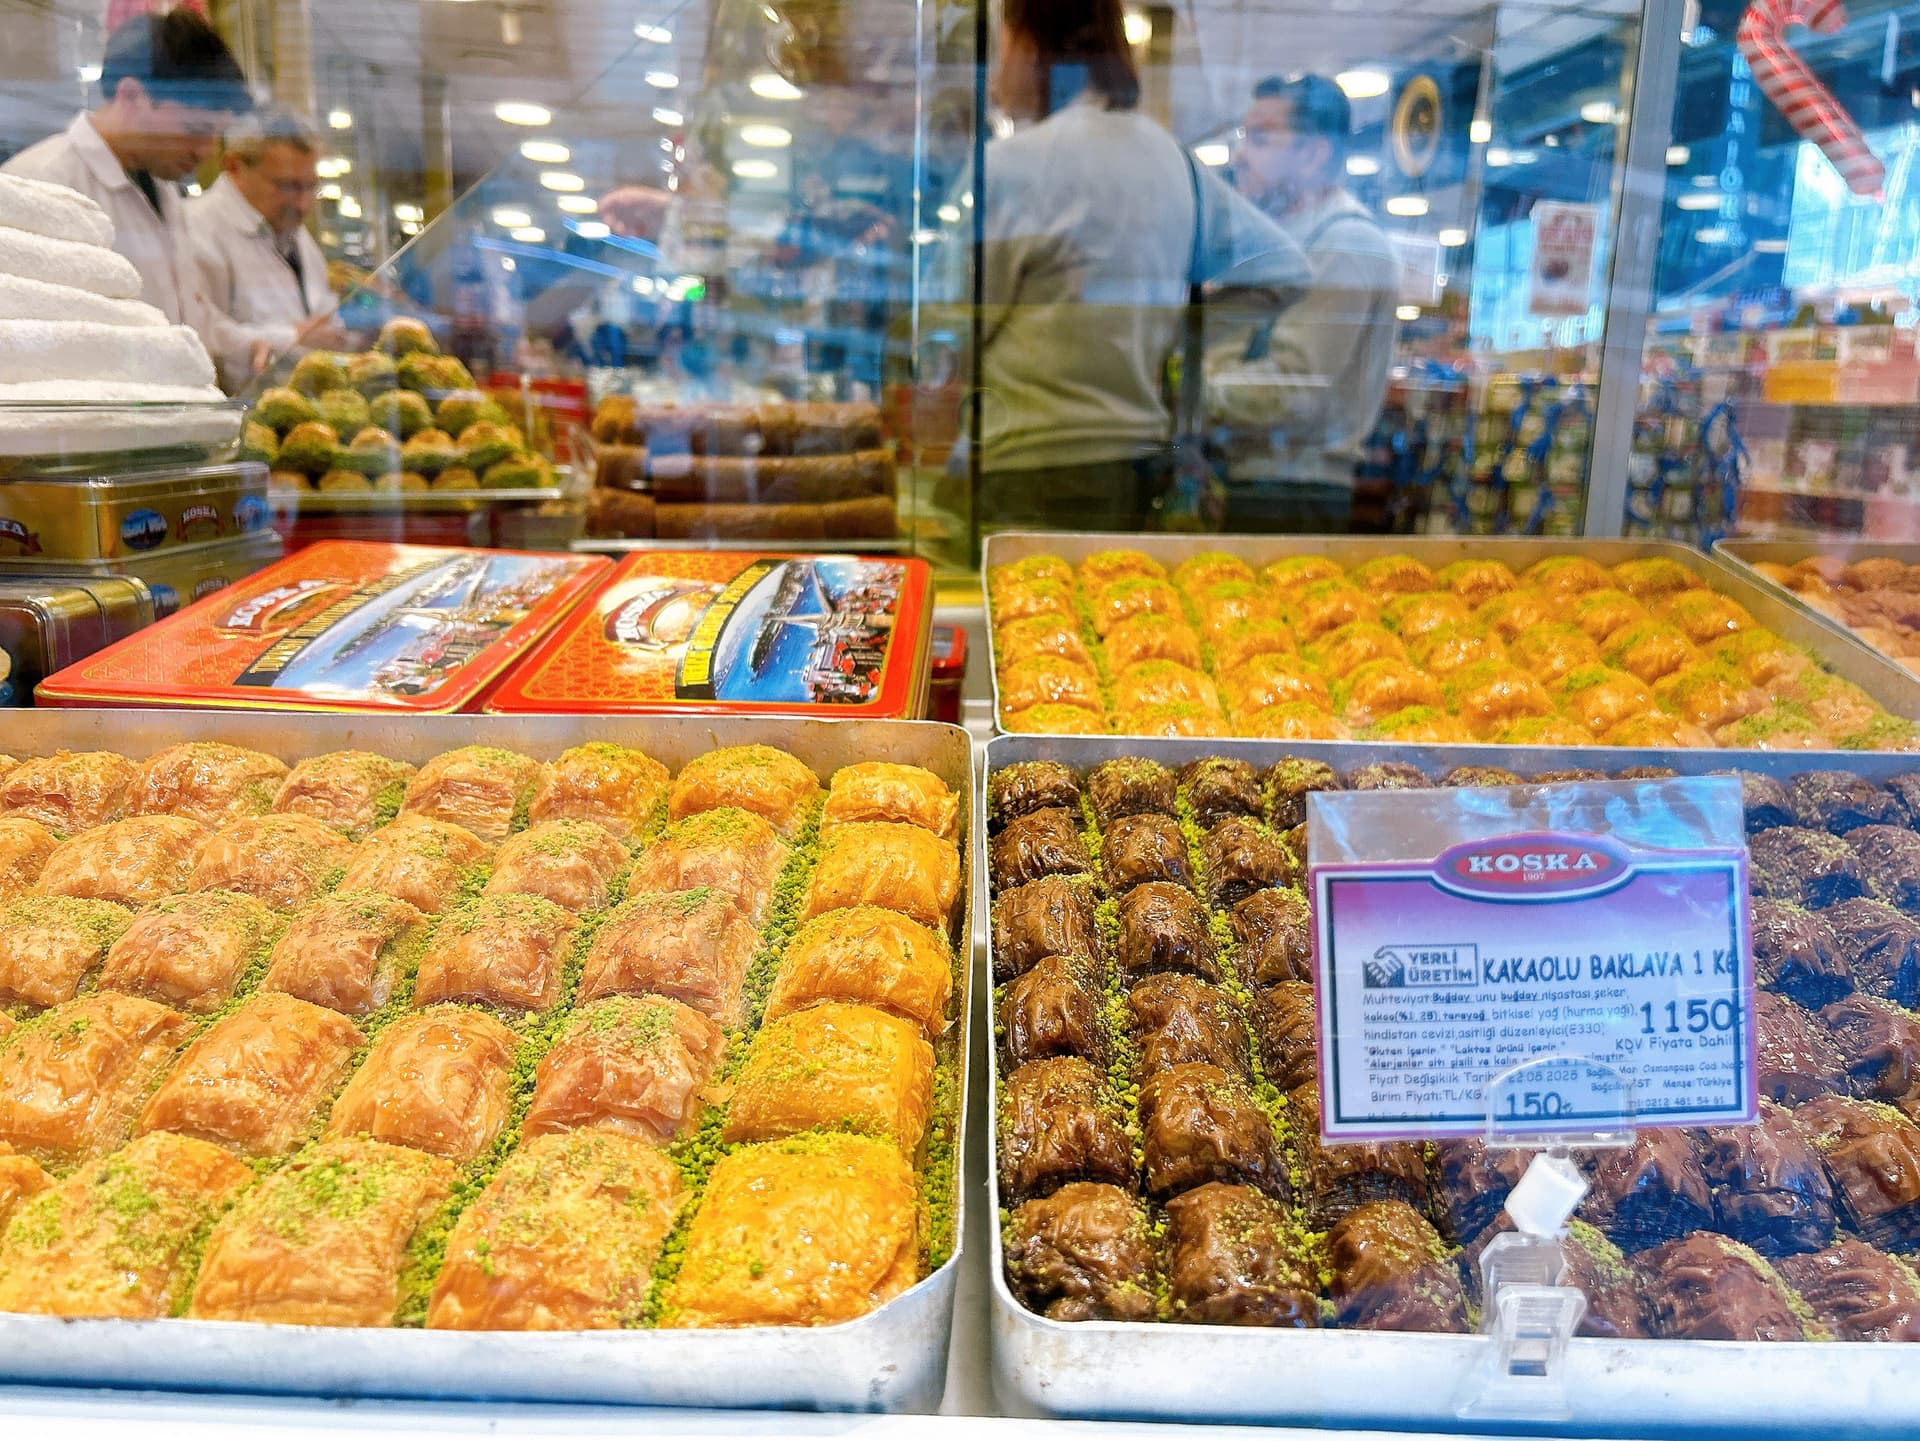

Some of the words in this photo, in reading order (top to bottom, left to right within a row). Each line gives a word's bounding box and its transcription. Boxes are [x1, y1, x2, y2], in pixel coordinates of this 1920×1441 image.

[183, 505, 218, 524] KOSKA
[227, 579, 327, 628] KOSKA
[1468, 853, 1598, 873] KOSKA
[1523, 872, 1546, 881] 1907
[1408, 949, 1459, 965] YERLİ
[1483, 956, 1581, 984] KAKAOLU
[1590, 951, 1684, 979] BAKLAVA
[1693, 949, 1703, 975] 1
[1408, 967, 1473, 983] ÜRETİM
[1538, 1006, 1559, 1022] yağ
[1363, 1029, 1417, 1041] hindistan
[1615, 1038, 1642, 1052] KDV
[1650, 1036, 1693, 1053] Fiyata
[1369, 1073, 1399, 1087] Fiyat
[1404, 1071, 1460, 1087] Değişiklik
[1371, 1091, 1401, 1103] Birim
